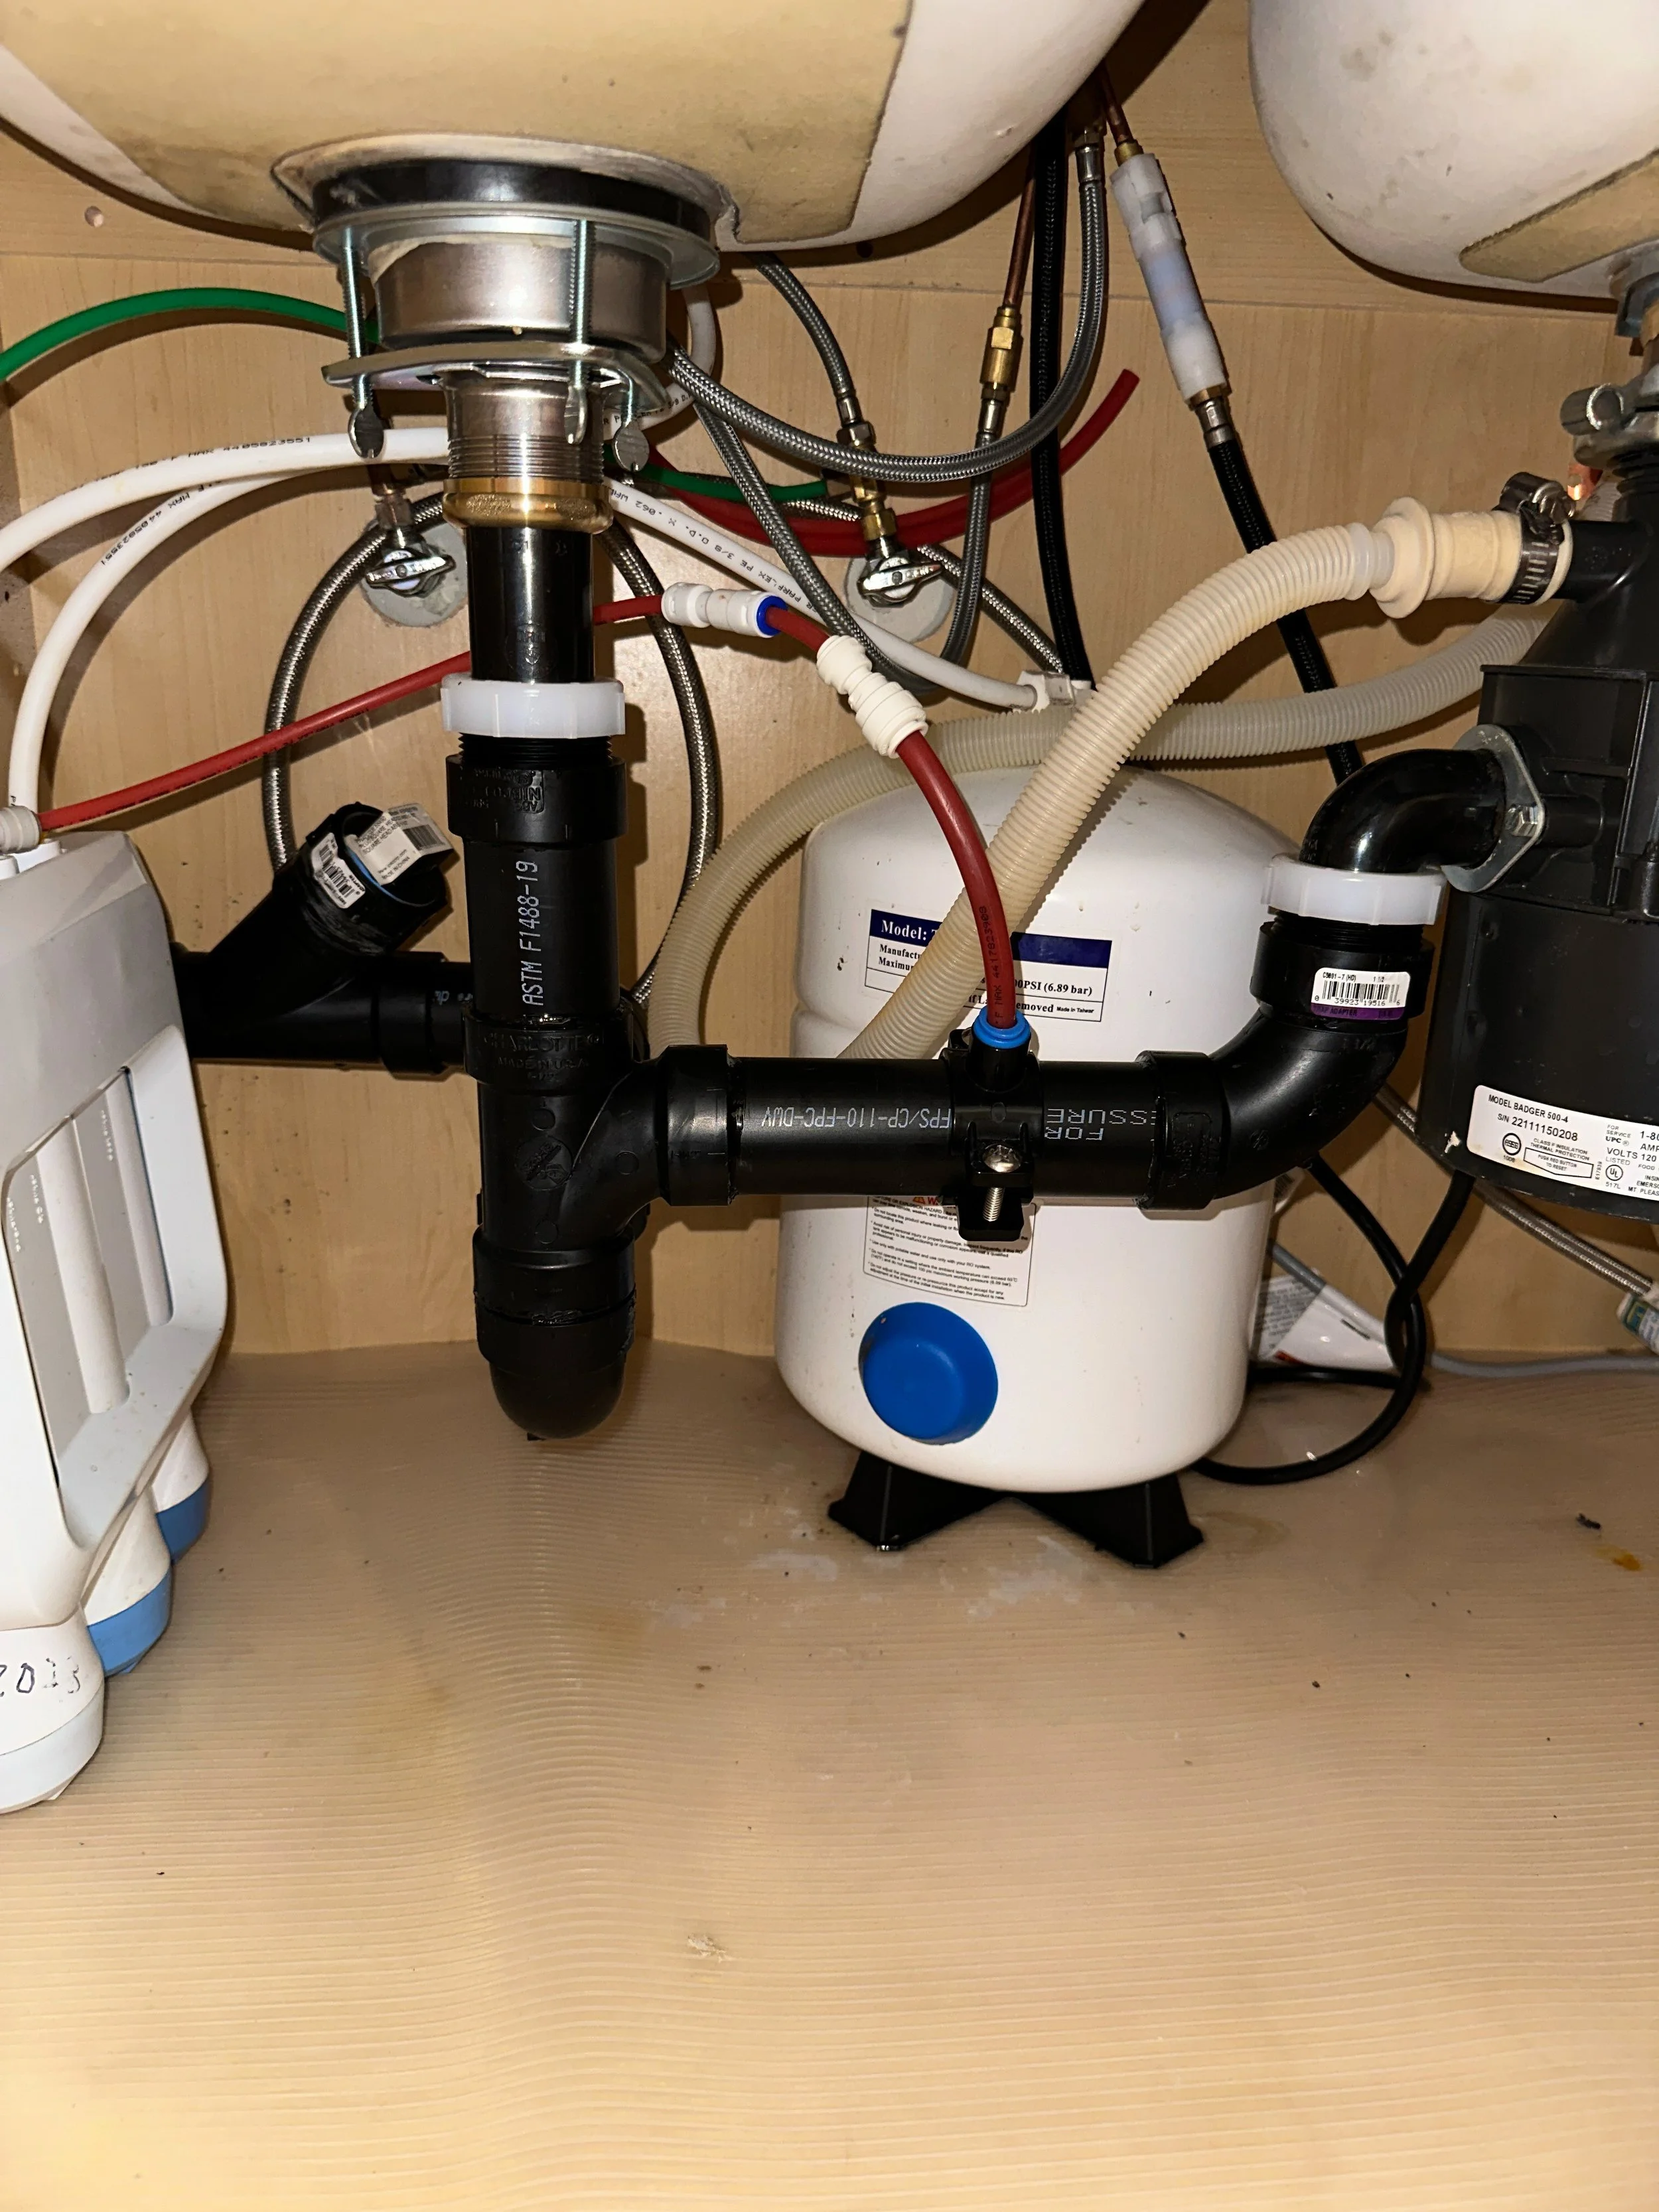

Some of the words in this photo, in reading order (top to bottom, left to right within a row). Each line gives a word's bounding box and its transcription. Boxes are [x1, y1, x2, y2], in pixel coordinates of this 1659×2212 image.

[635, 501, 662, 516] .062
[685, 526, 709, 545] O.D.
[714, 544, 735, 560] 3/8
[740, 559, 754, 571] PE
[516, 860, 541, 953] F1488-19
[881, 920, 926, 940] Model:
[879, 957, 914, 971] Maximu
[521, 960, 543, 1007] ASTM
[1044, 983, 1068, 993] (6.89
[1071, 985, 1092, 996] bar)
[1016, 1001, 1054, 1012] emoved
[1488, 1094, 1512, 1108] MODEL
[1514, 1102, 1546, 1118] BADGER
[1548, 1112, 1568, 1123] 500-4
[1045, 1127, 1104, 1141] FOR
[1498, 1113, 1509, 1123] S/N
[1512, 1116, 1578, 1142] 22111150208
[1531, 1142, 1553, 1153] THERMAL
[1555, 1149, 1589, 1161] PROTECTION
[1534, 1138, 1551, 1146] CLASS
[1556, 1143, 1588, 1155] INSULATION
[1606, 1156, 1630, 1165] LISTED
[1607, 1147, 1638, 1159] VOLTS
[1641, 1153, 1657, 1162] 120
[1559, 1159, 1577, 1168] BUTTON
